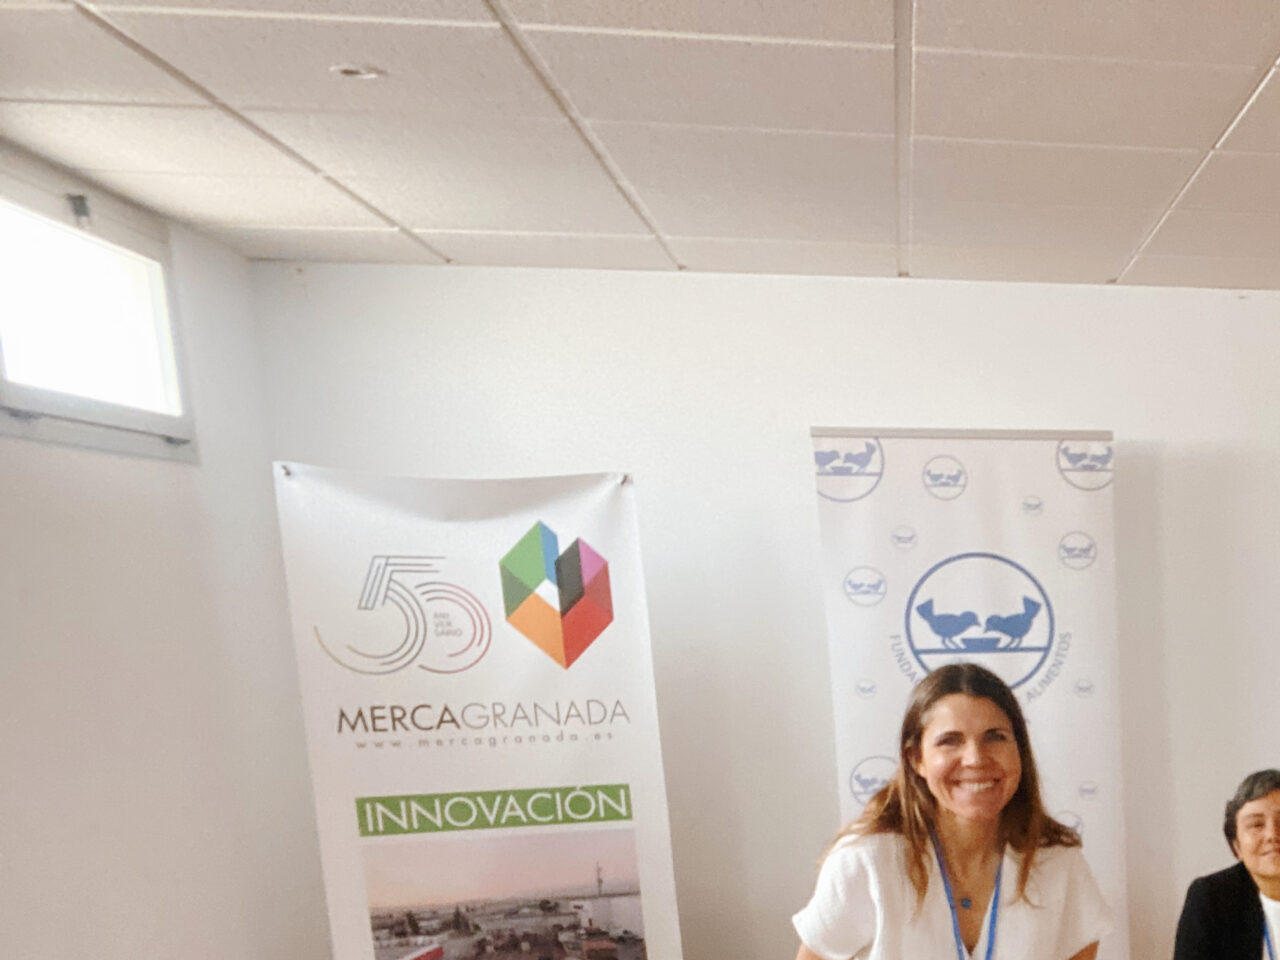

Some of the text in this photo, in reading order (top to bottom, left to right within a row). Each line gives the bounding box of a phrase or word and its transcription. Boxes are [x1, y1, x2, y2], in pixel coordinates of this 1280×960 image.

[1025, 631, 1072, 703] ALIMENTOS
[337, 699, 631, 733] MERCAGRANADA
[355, 730, 614, 748] www.mercagranada.es
[363, 785, 629, 832] INNOVACIÓN
